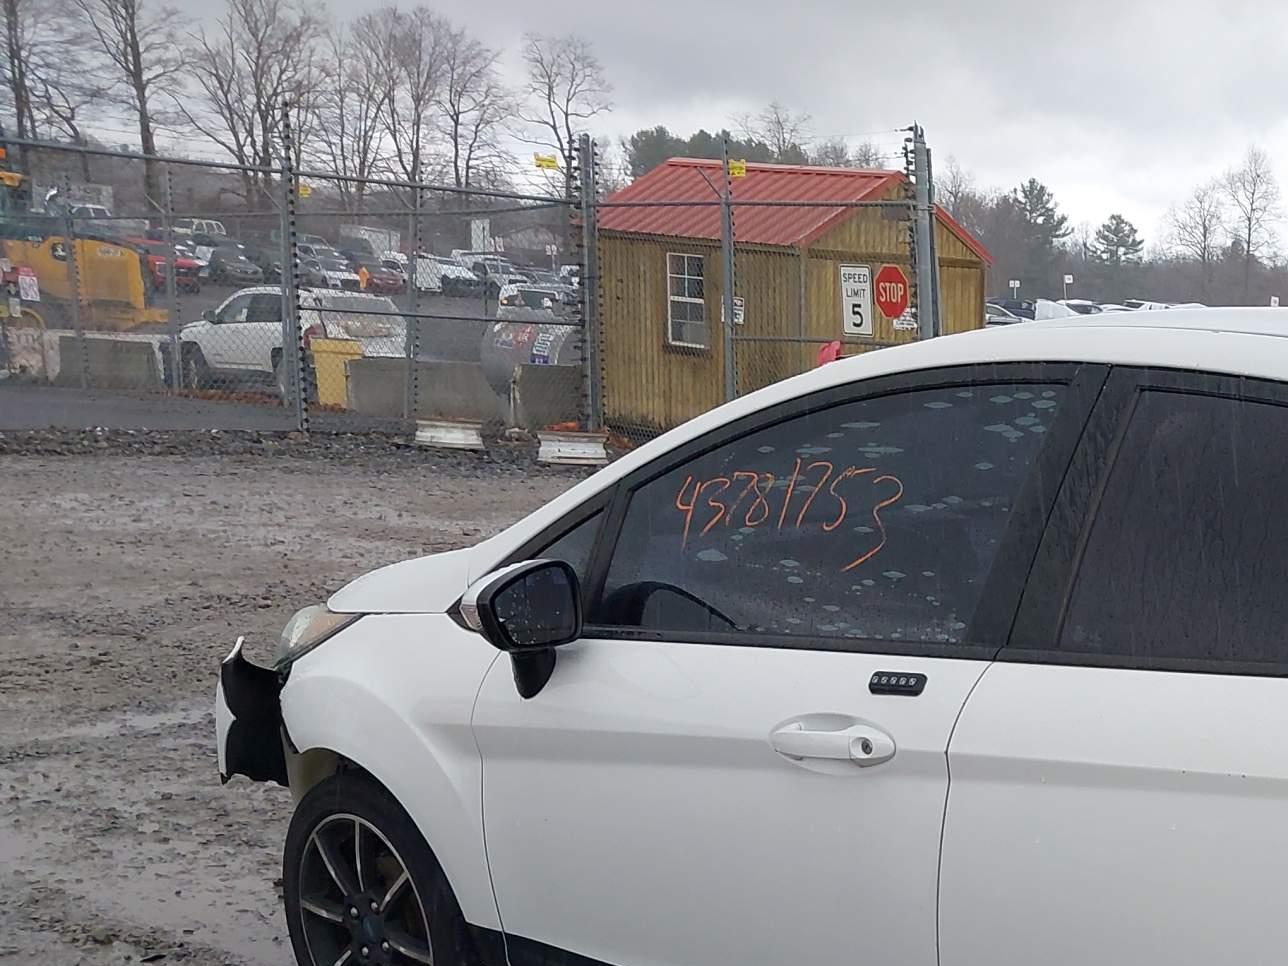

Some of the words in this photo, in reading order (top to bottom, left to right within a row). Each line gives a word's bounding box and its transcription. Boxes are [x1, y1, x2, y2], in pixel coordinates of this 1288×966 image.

[842, 272, 868, 284] SPEED
[845, 287, 867, 298] LIMIT
[878, 281, 905, 304] STOP
[851, 303, 864, 328] 5
[675, 456, 905, 573] 43781753
